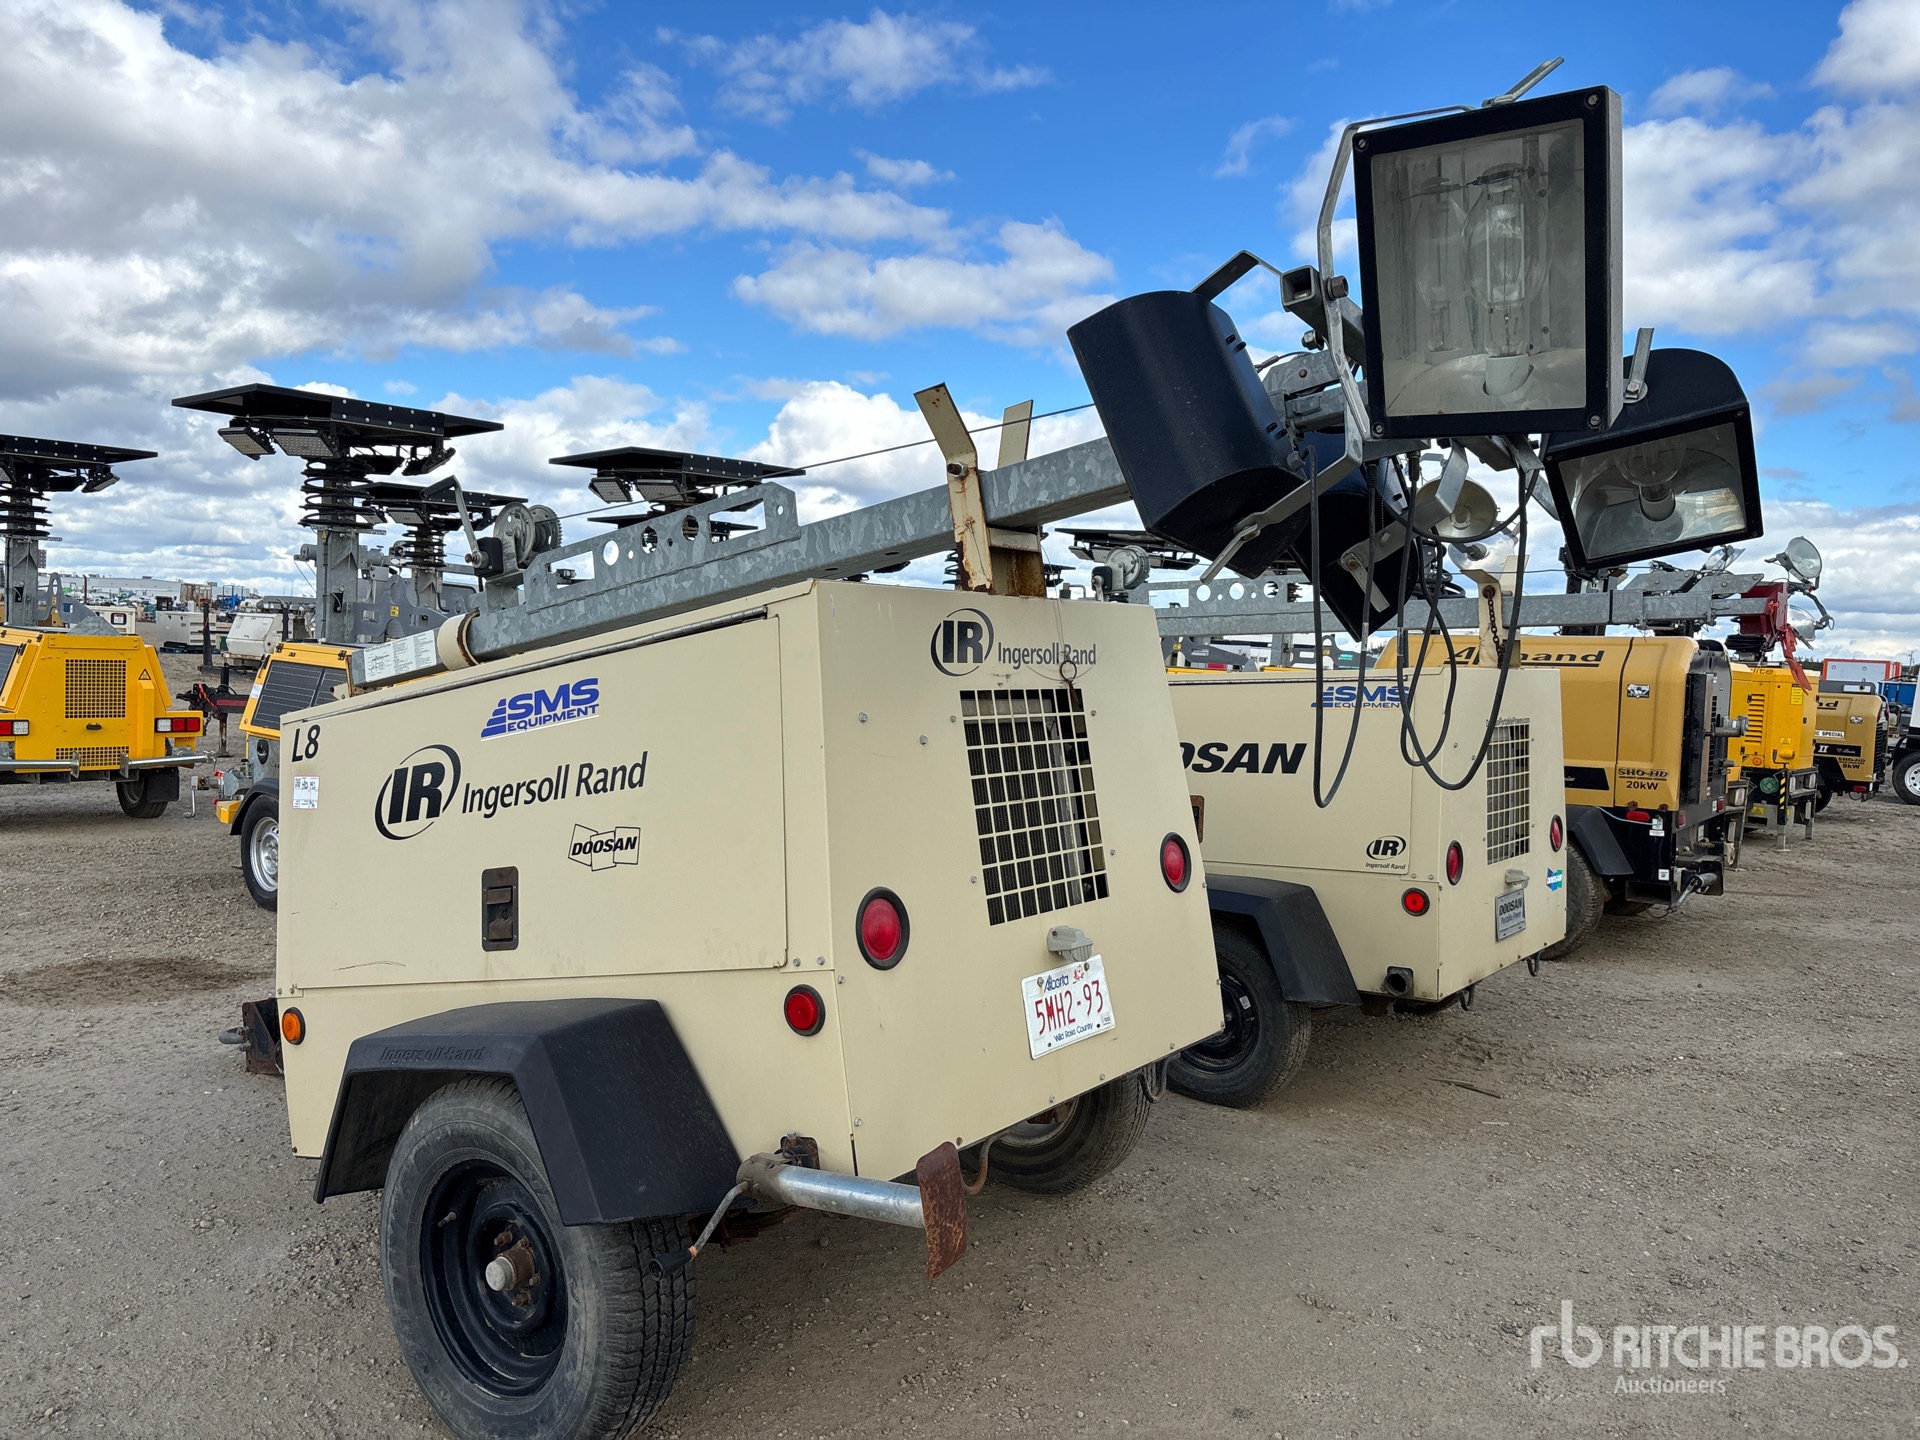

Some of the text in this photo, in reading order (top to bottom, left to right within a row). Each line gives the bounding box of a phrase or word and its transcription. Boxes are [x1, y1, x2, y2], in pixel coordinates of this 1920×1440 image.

[998, 642, 1096, 670] Ingersoll Rand
[508, 677, 600, 721] SMS
[508, 704, 600, 732] EQUIPMENT
[291, 724, 321, 762] L8
[462, 751, 648, 818] Ingersoll Rand
[1618, 768, 1668, 777] SHO-HD
[1626, 780, 1659, 790] 20kW
[571, 836, 638, 856] DOOSAN
[1499, 897, 1523, 916] DOOSAN
[1044, 974, 1069, 993] Alberta
[1035, 980, 1103, 1035] 5MH2-93
